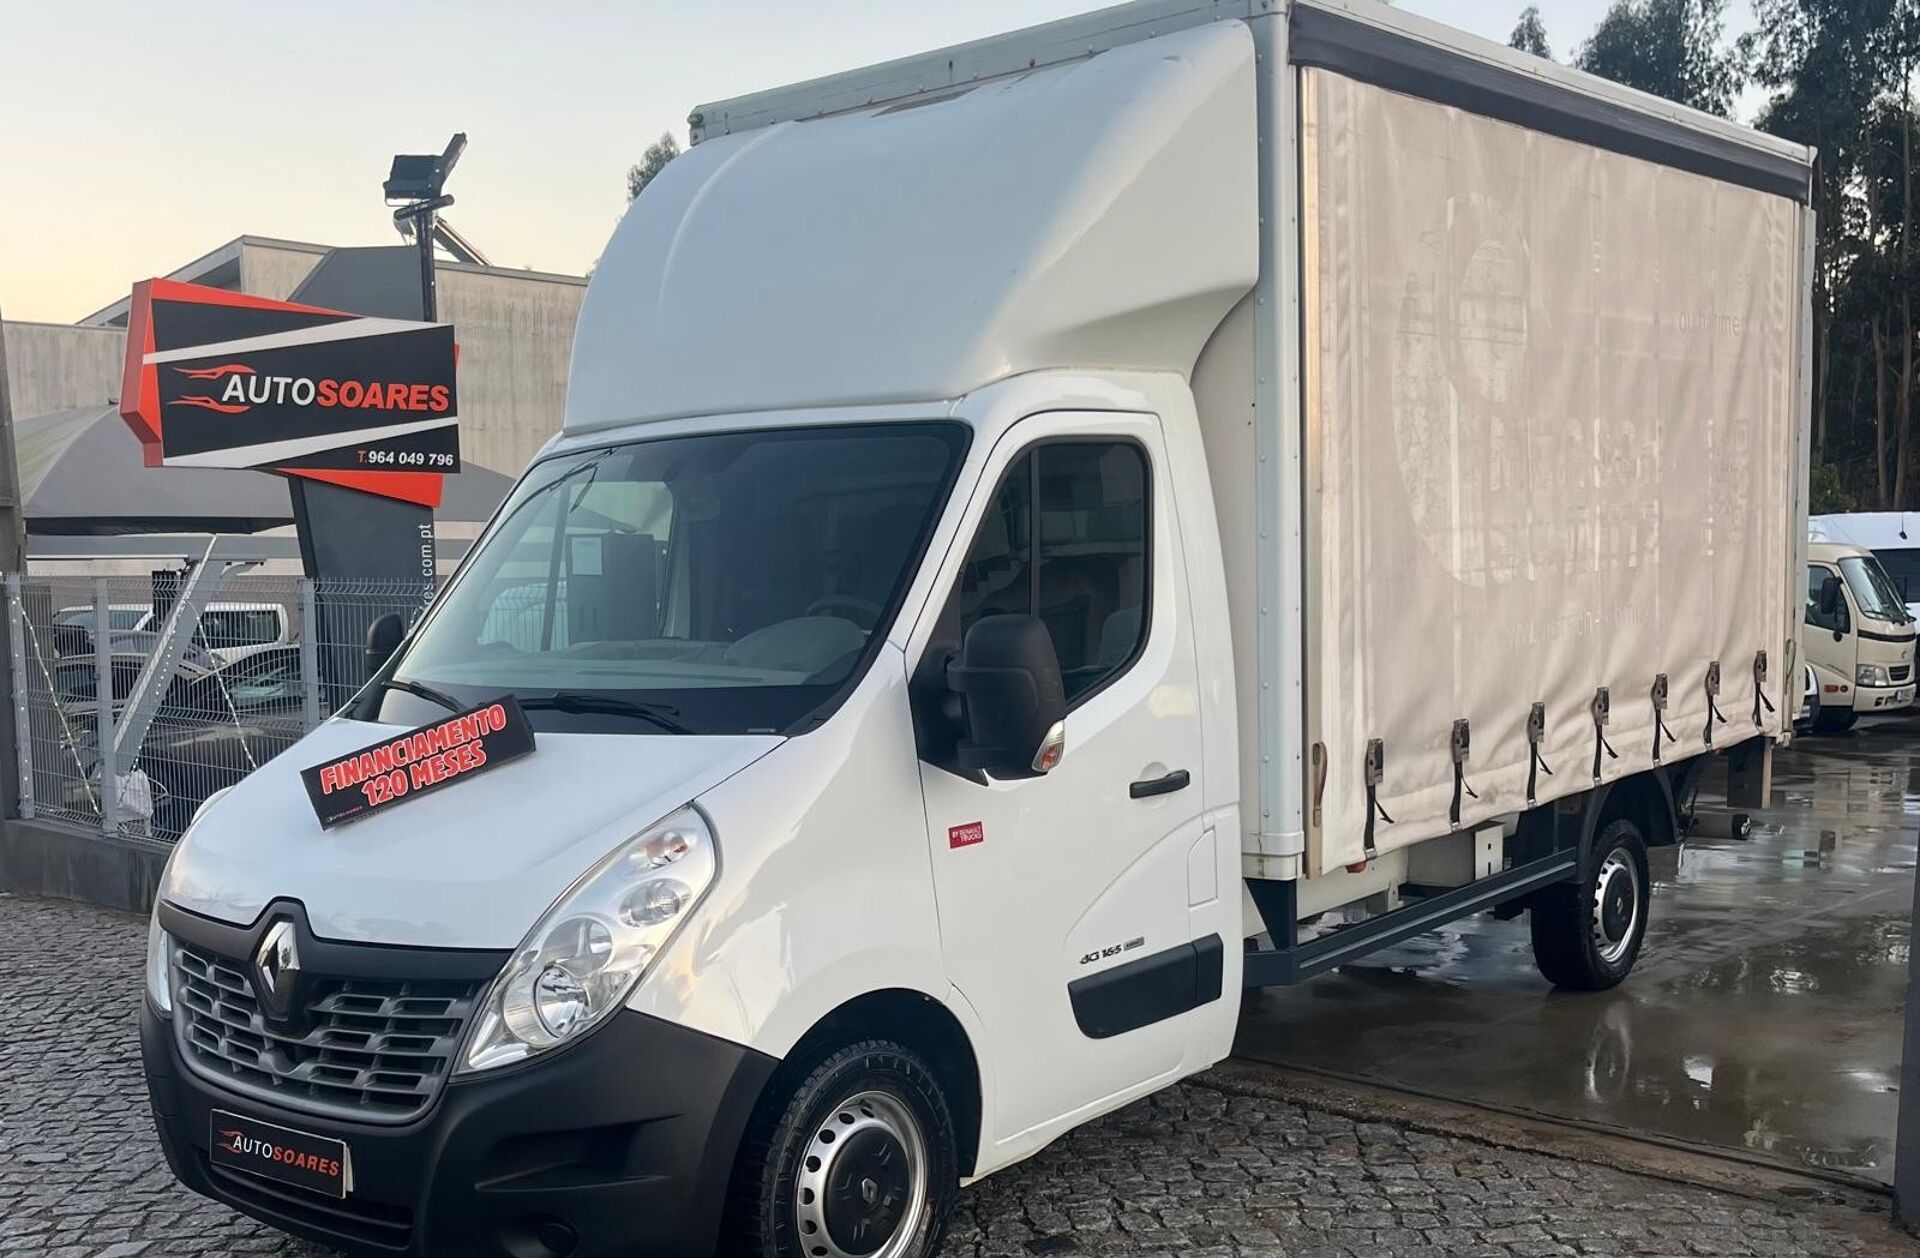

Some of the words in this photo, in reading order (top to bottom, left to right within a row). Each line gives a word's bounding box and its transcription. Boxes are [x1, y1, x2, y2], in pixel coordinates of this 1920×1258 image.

[221, 374, 450, 412] AUTOSOARES
[398, 453, 425, 465] 049
[428, 453, 454, 466] 796
[319, 703, 506, 796] FINANCIAMENTO
[361, 769, 409, 807] 120
[409, 739, 487, 790] MESES
[233, 1135, 340, 1177] AUTOSOARES
